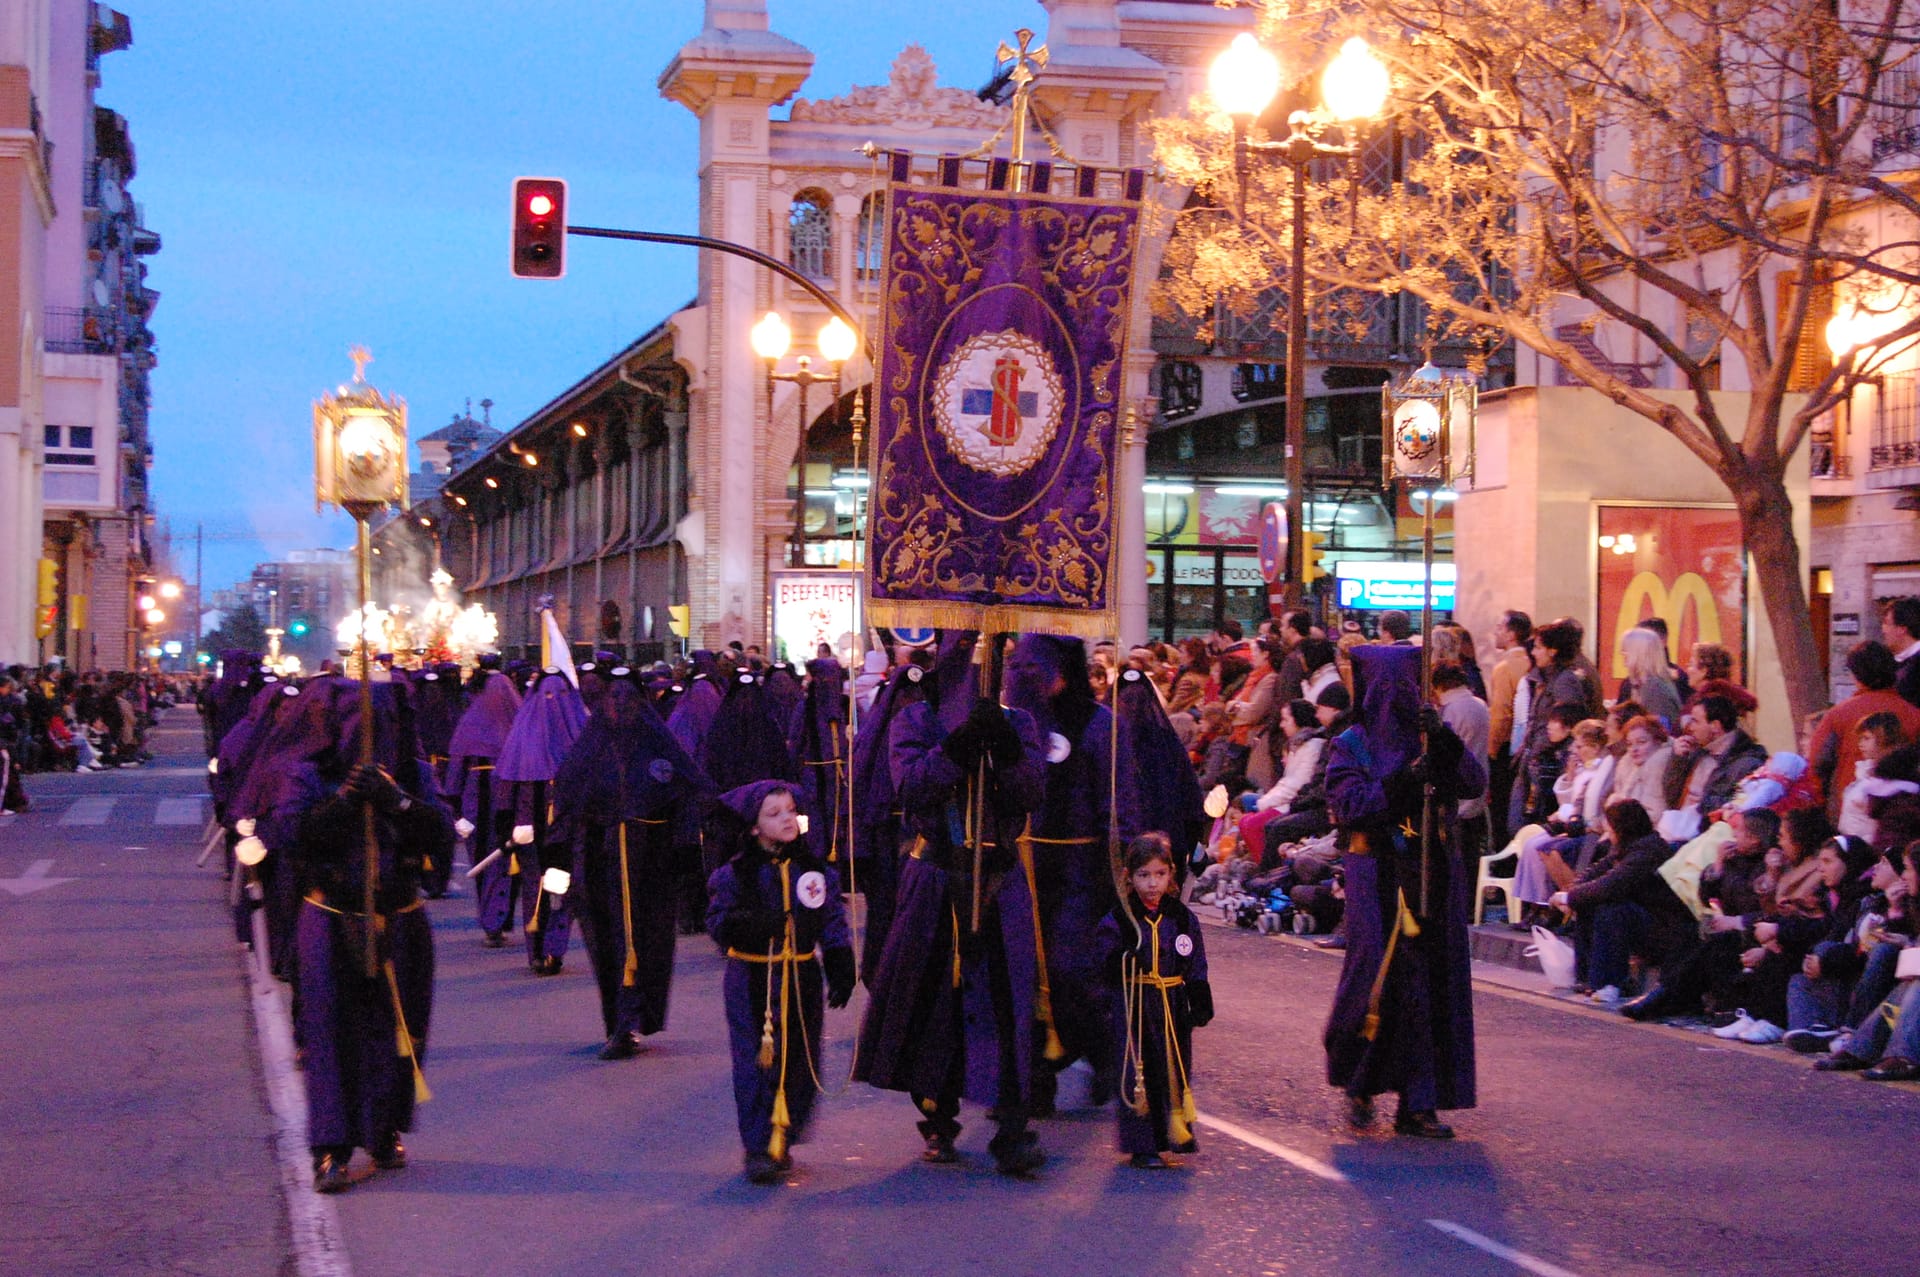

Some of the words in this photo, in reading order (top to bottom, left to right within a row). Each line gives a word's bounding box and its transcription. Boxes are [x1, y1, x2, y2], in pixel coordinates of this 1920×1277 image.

[1192, 567, 1217, 578] PAR
[781, 584, 854, 604] BEEFEATER
[1341, 580, 1363, 606] P
